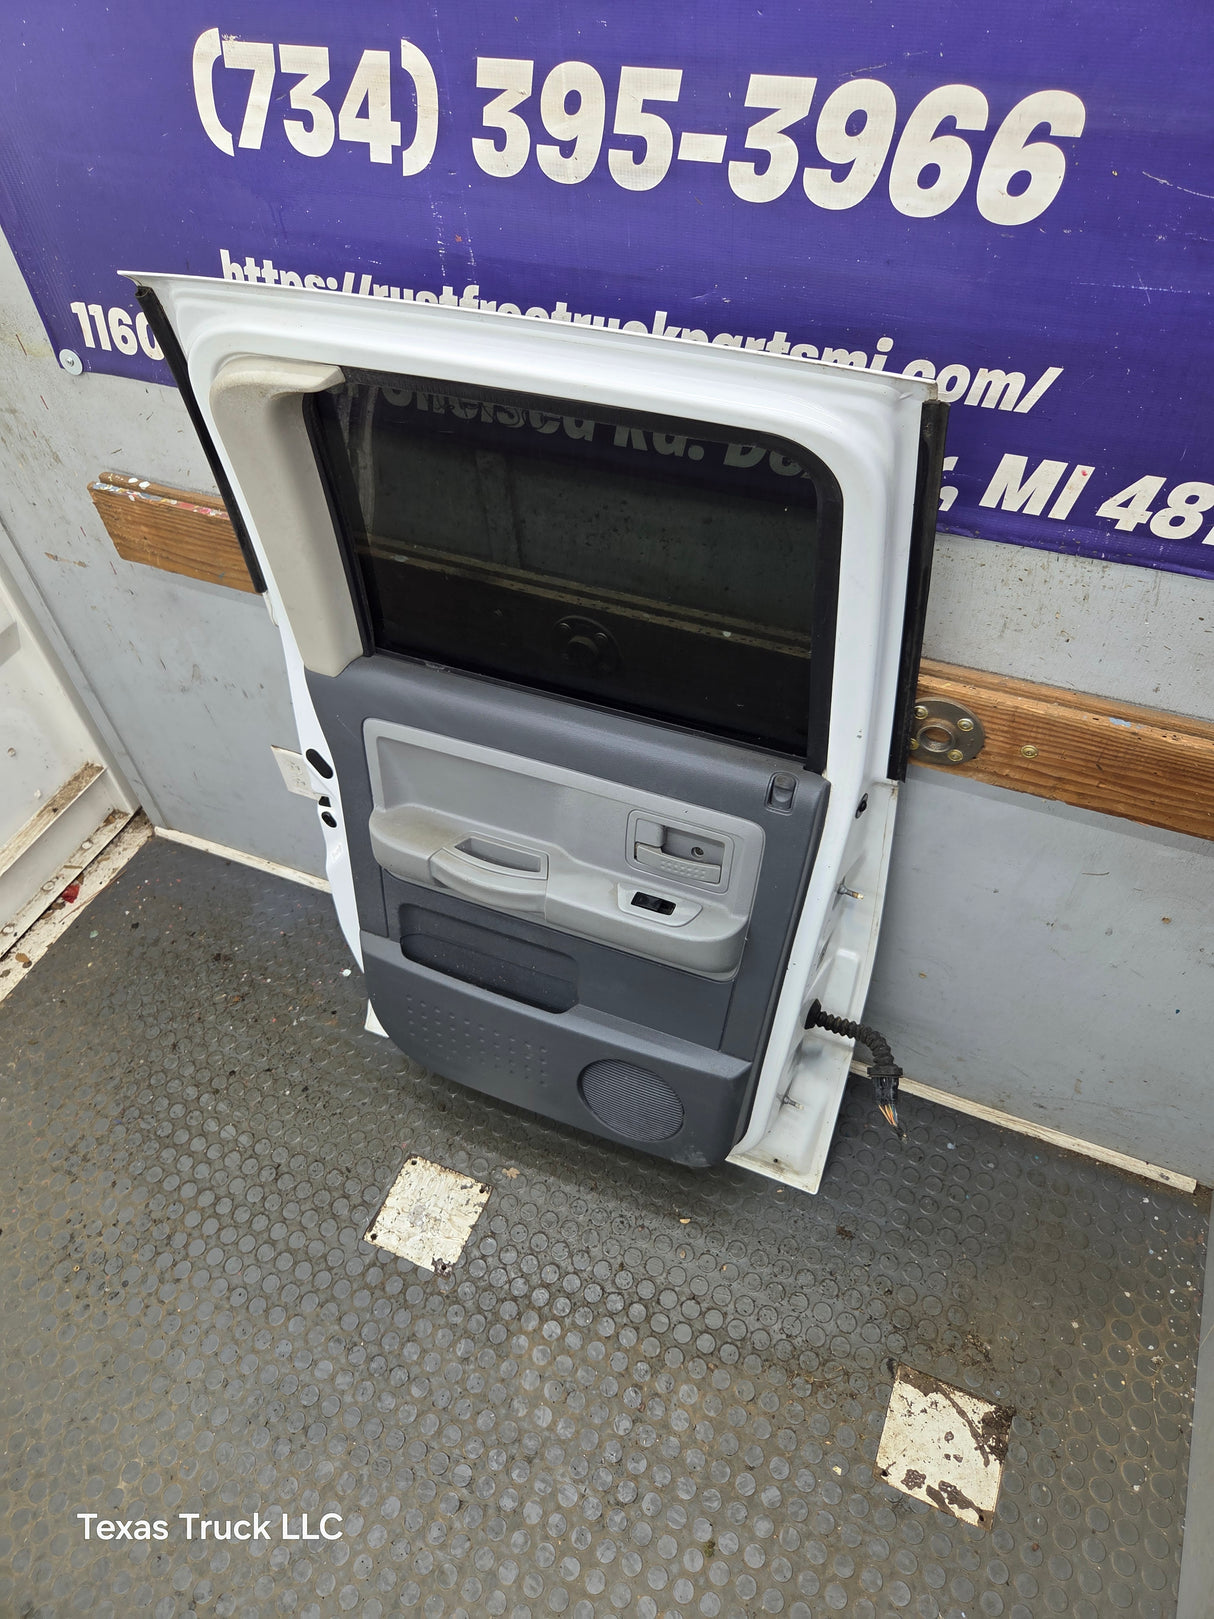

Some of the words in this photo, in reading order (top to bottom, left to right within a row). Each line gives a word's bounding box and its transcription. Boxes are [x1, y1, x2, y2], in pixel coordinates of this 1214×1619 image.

[192, 27, 438, 176] (734)
[472, 57, 1086, 225] 395-3966
[979, 453, 1096, 520] MI
[1095, 475, 1214, 545] 48
